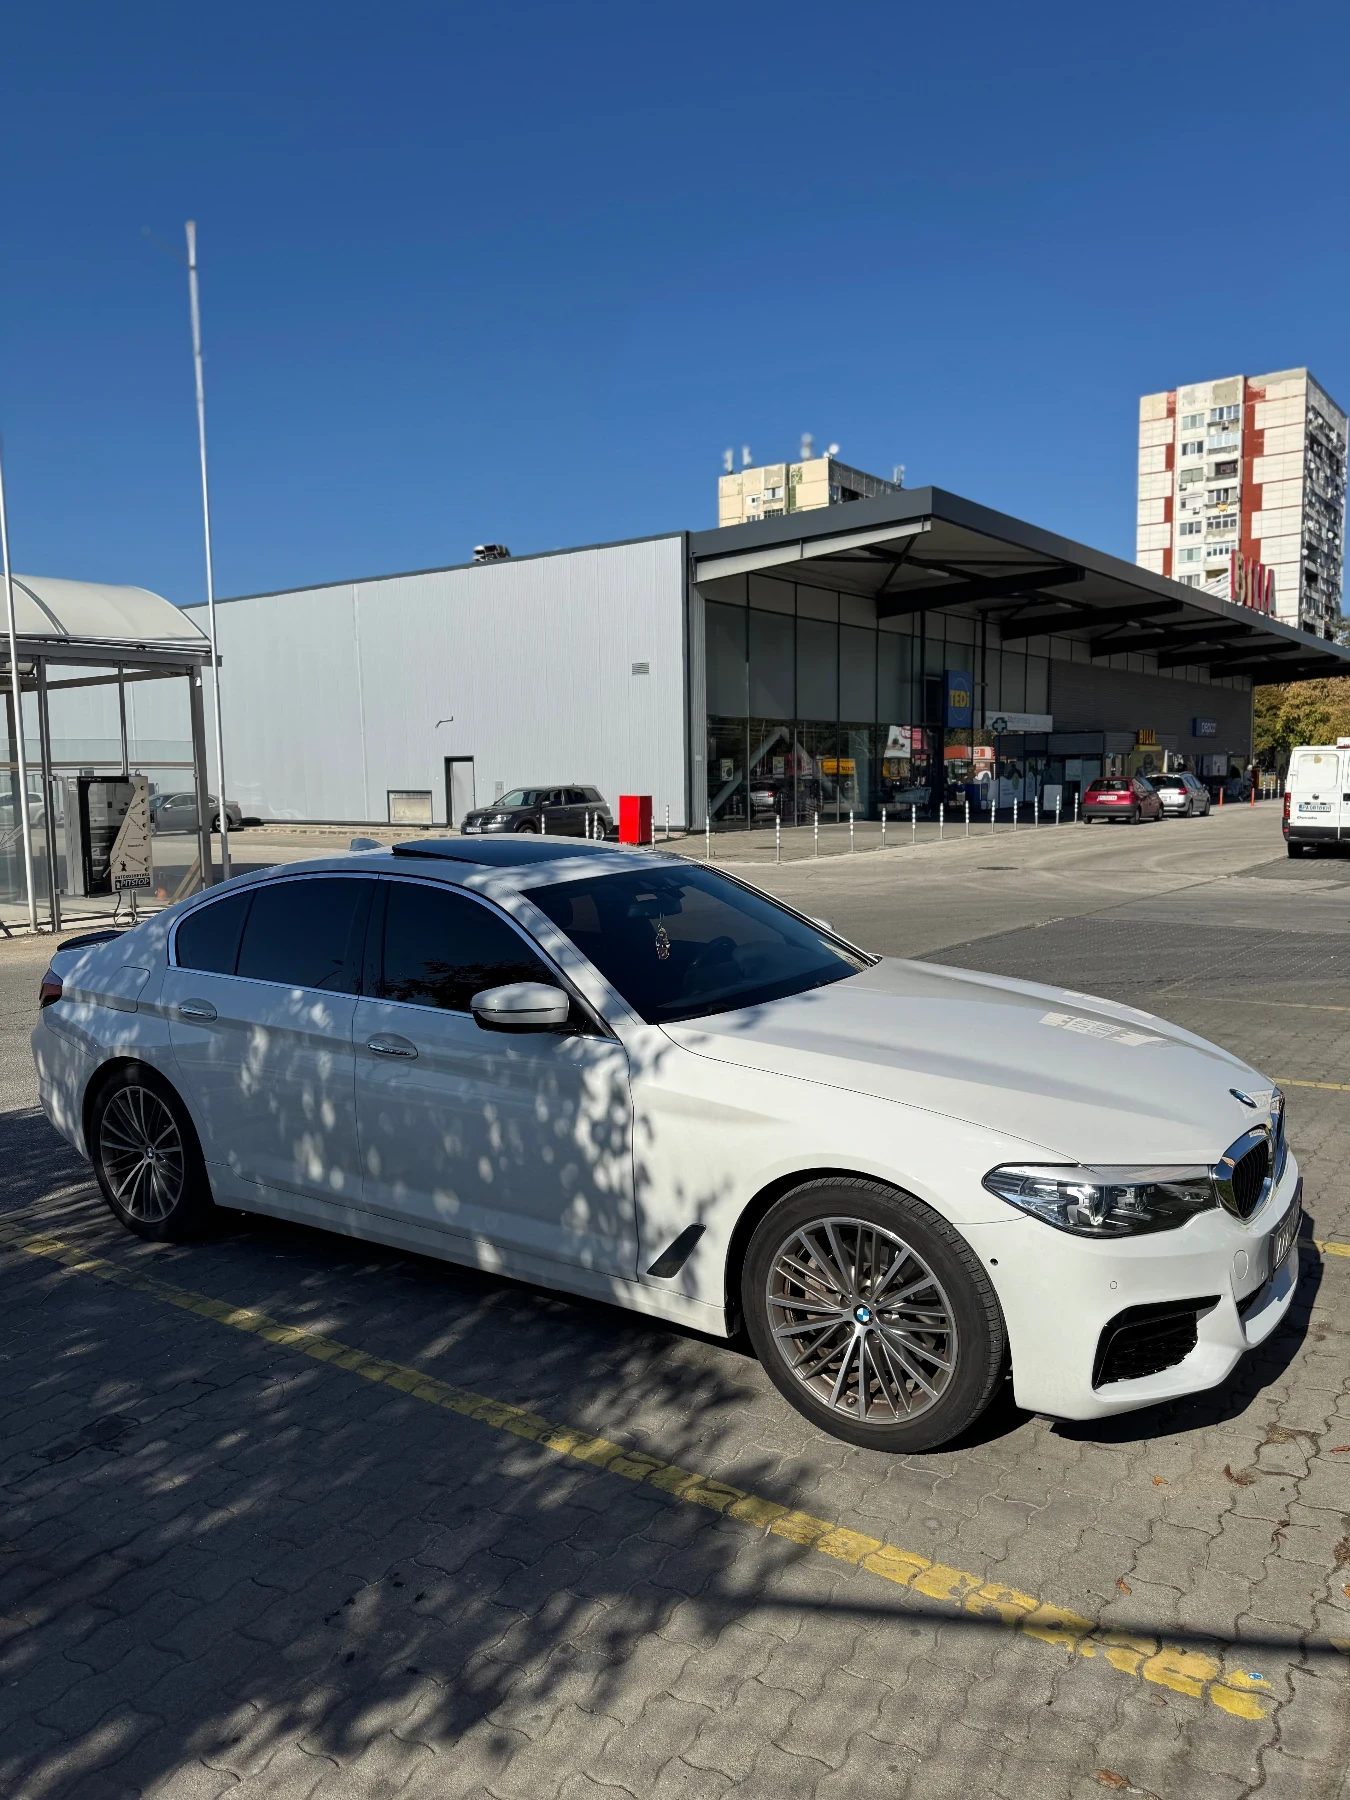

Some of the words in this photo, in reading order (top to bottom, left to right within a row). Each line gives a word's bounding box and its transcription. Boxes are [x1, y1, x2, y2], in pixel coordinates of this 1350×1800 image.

[950, 690, 970, 708] TEDi
[1139, 729, 1155, 744] BILLA
[121, 878, 149, 886] PITSTOP
